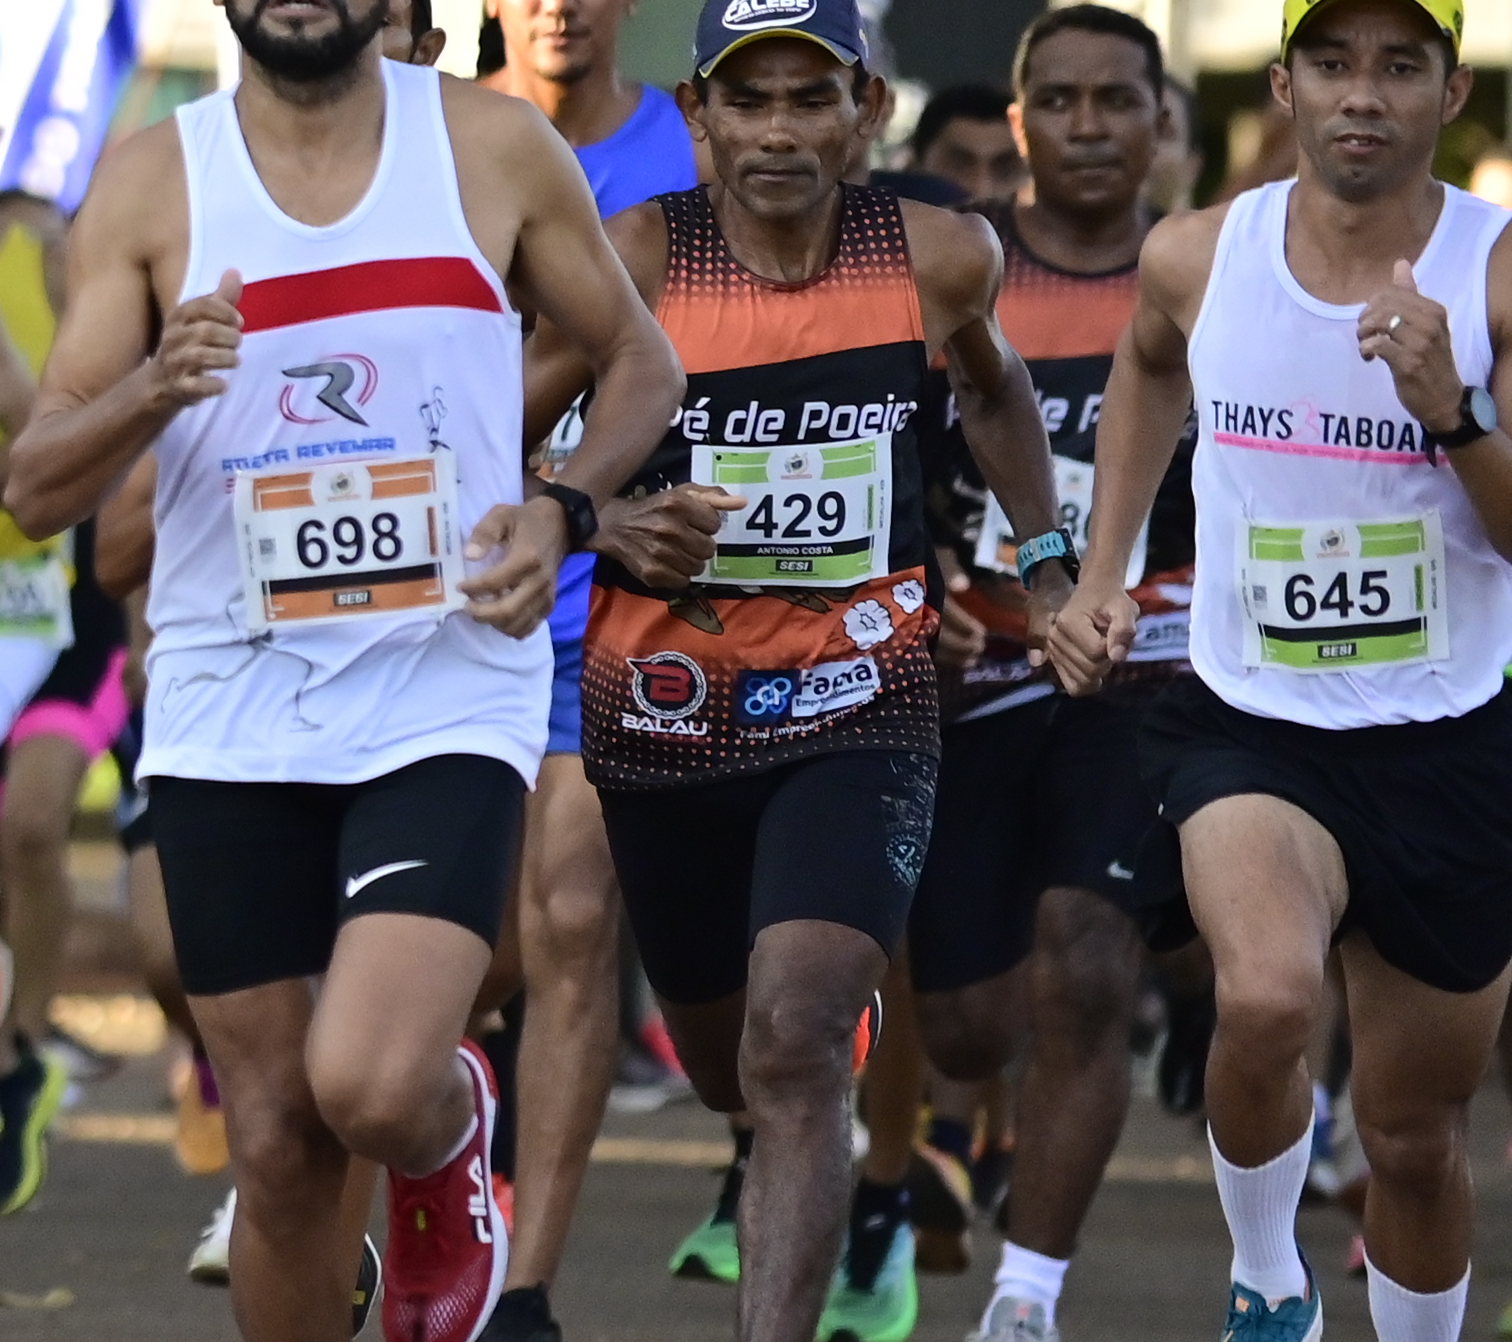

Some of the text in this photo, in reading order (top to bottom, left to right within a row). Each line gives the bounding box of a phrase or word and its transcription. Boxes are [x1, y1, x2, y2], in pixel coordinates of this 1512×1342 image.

[724, 400, 786, 443] de
[1212, 400, 1294, 441] THAYS
[746, 491, 846, 539] 429
[296, 512, 404, 569] 698
[757, 545, 834, 555] ANTONIO COSTA
[779, 561, 809, 571] SESI
[337, 591, 369, 604] SESI
[1284, 570, 1391, 622] 645
[1321, 644, 1353, 657] SESI
[621, 711, 708, 736] BALAU
[467, 1153, 492, 1244] FILA
